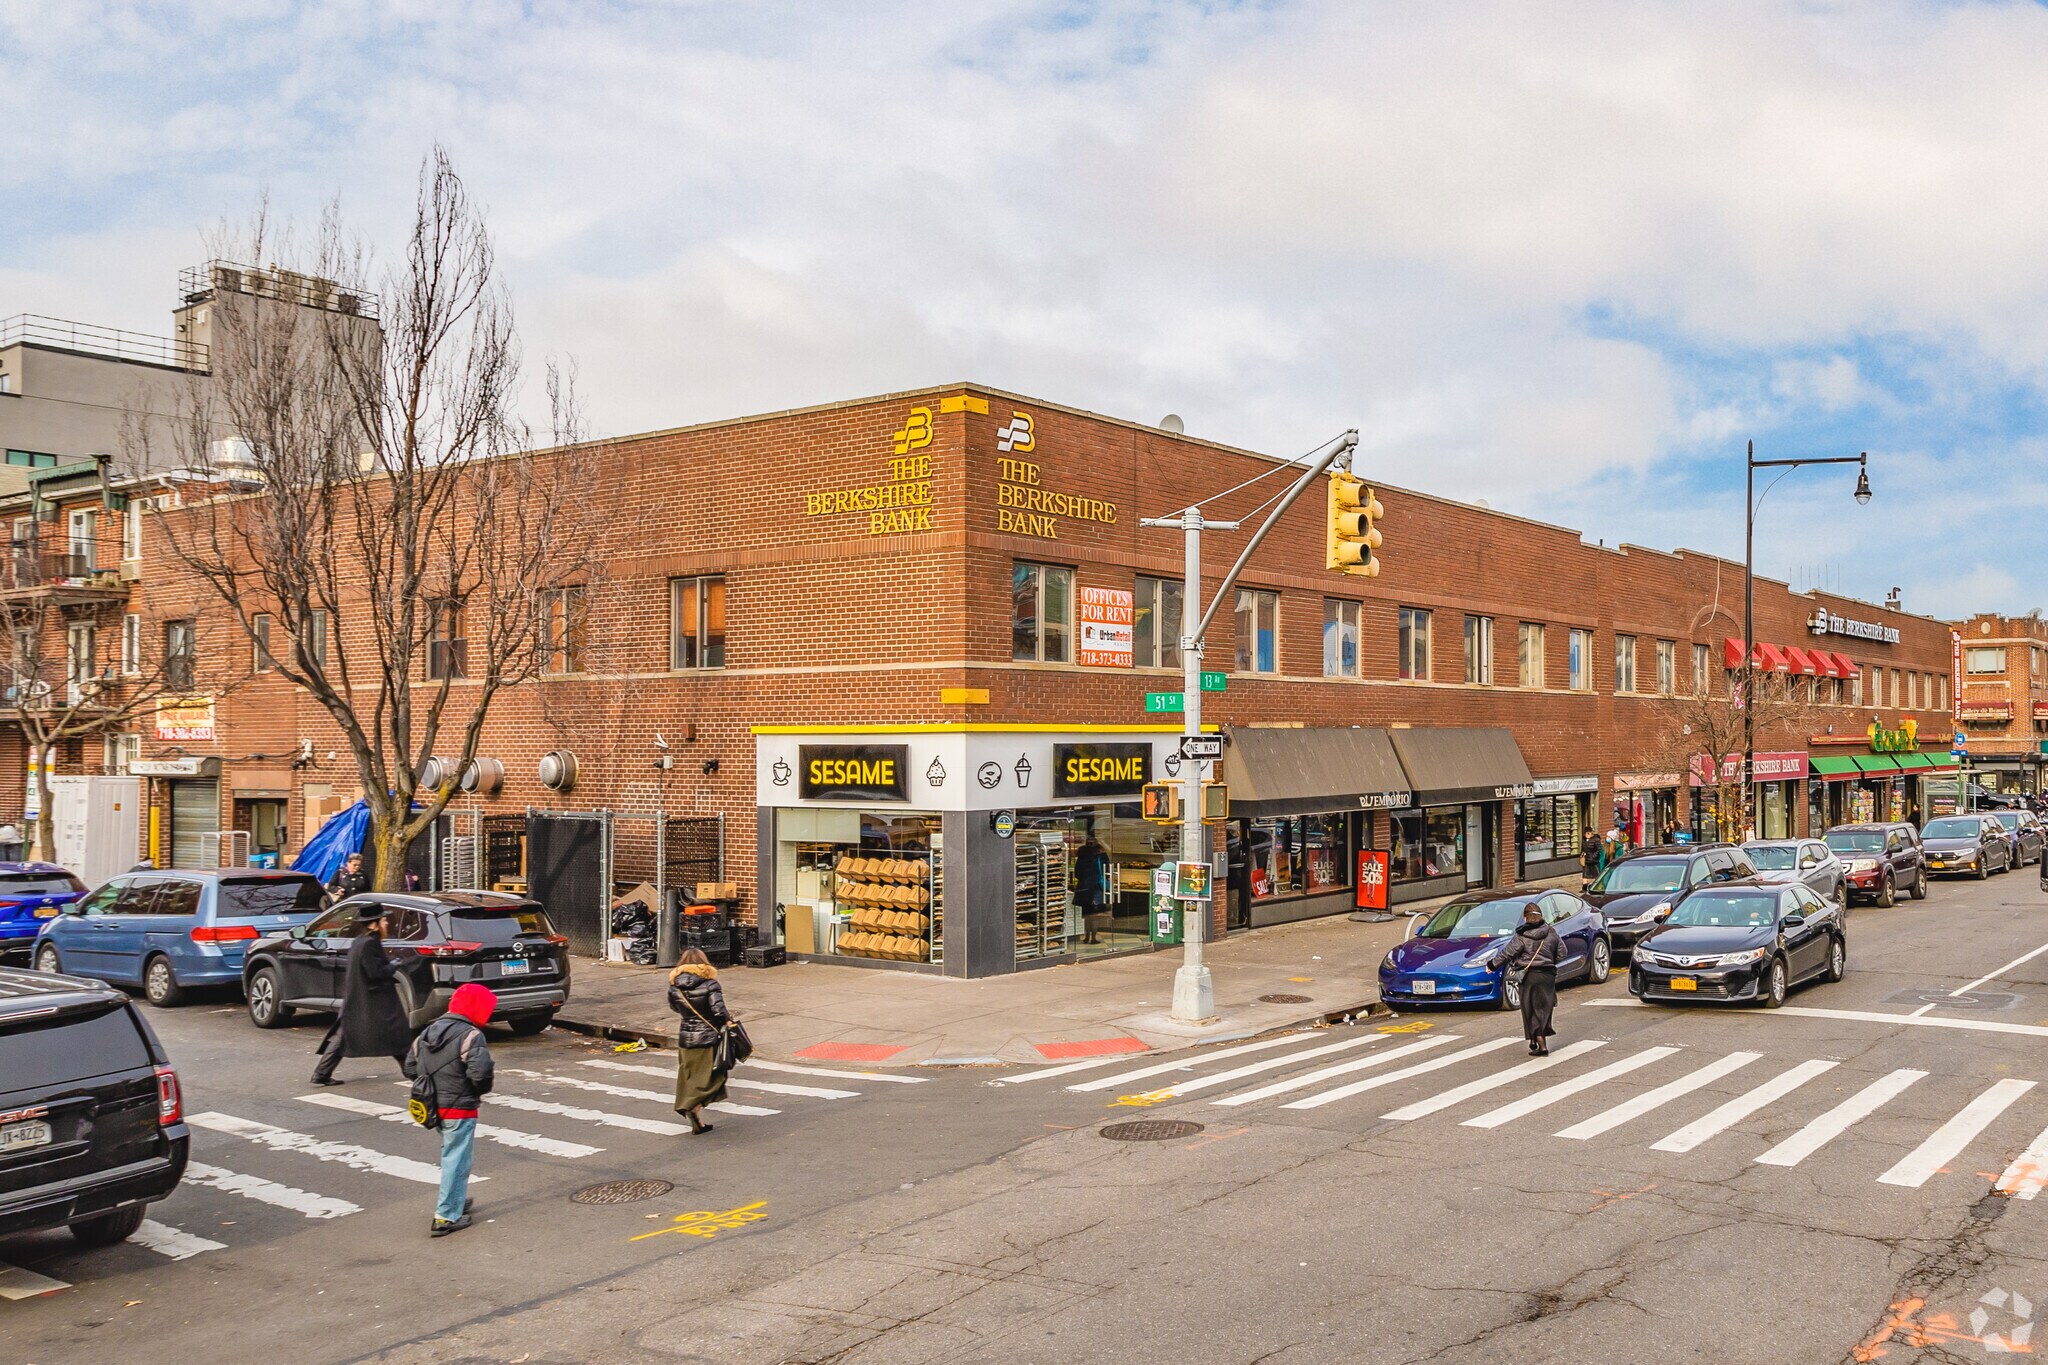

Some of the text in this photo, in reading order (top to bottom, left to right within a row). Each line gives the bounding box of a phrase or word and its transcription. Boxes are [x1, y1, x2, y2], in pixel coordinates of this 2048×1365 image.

[888, 455, 933, 481] THE
[997, 457, 1041, 485] THE
[806, 482, 934, 516] BERKSHIRE
[996, 484, 1118, 524] BERKSHIRE
[869, 507, 933, 535] BANK
[996, 509, 1058, 540] BANK
[1084, 587, 1128, 607] OFFICES
[1081, 603, 1132, 623] FOR RENT
[1829, 615, 1900, 644] THE BERKSHIRE BANK
[1082, 651, 1132, 666] 718-373-0333
[1205, 674, 1213, 689] 13
[1155, 695, 1176, 710] 51 St
[1186, 743, 1217, 753] ONE WAY
[810, 760, 894, 785] SESAME
[1066, 757, 1142, 783] SESAME
[1782, 758, 1800, 773] BANK
[1361, 862, 1383, 873] SALE
[1257, 878, 1269, 896] SALE
[1361, 872, 1383, 884] 50%
[0, 1105, 49, 1123] GMC
